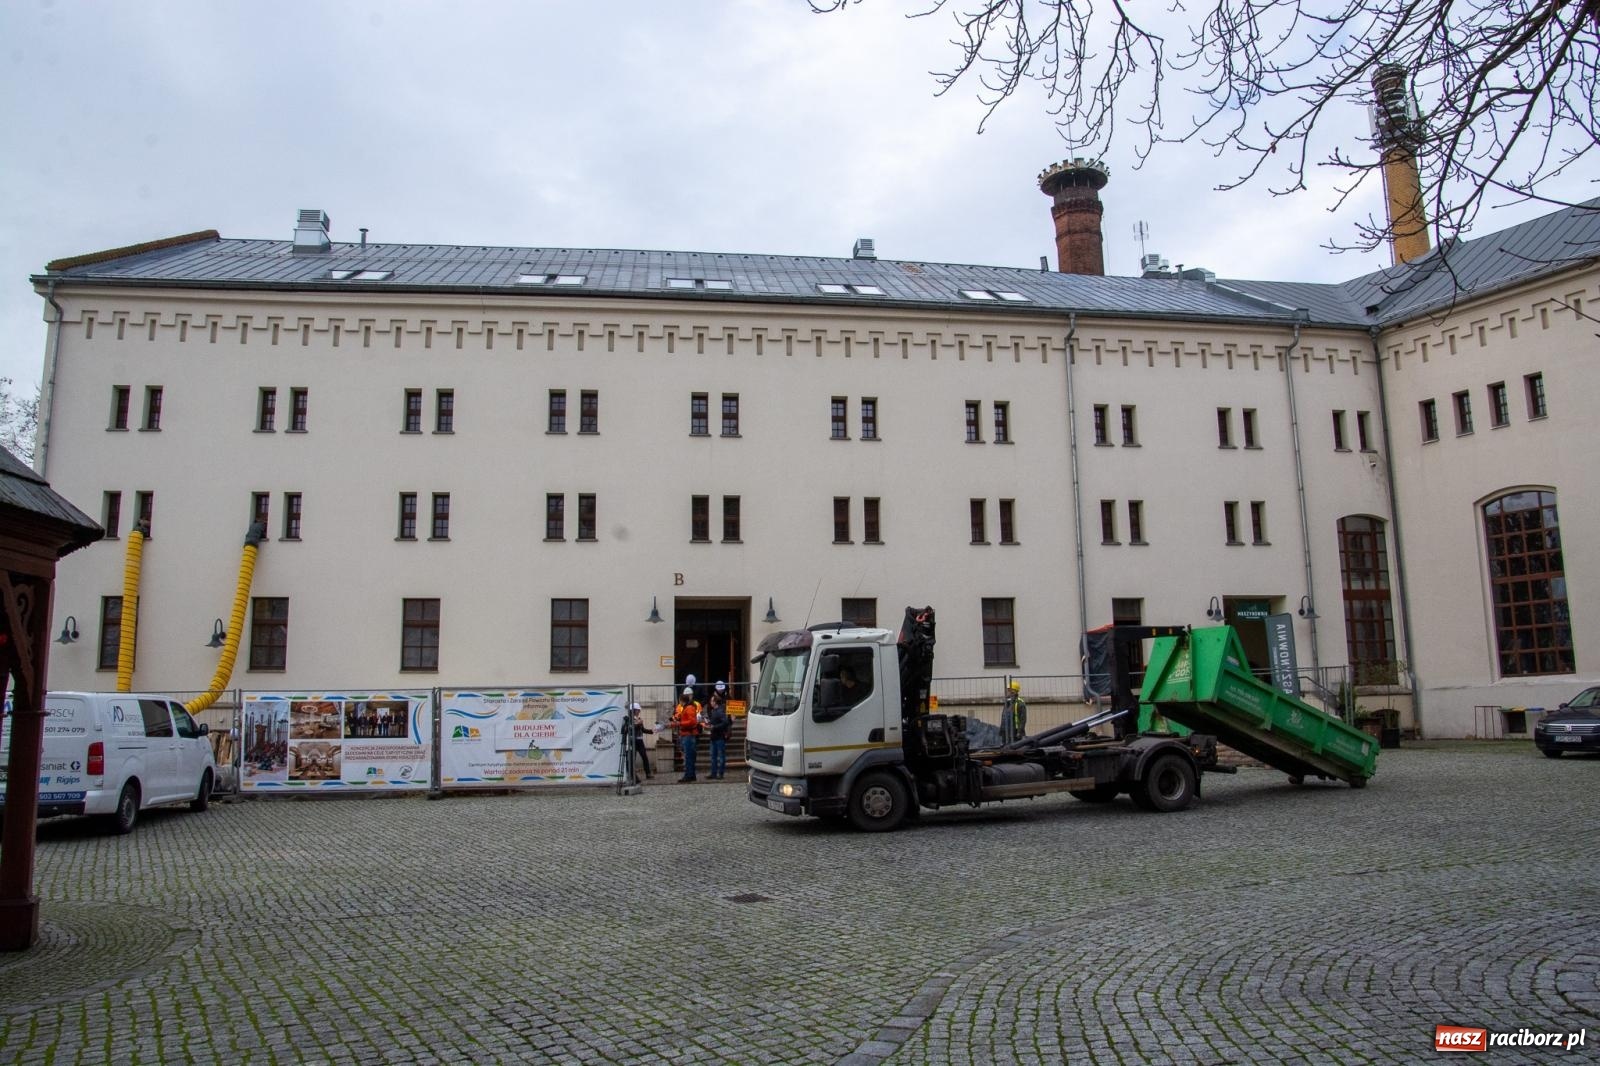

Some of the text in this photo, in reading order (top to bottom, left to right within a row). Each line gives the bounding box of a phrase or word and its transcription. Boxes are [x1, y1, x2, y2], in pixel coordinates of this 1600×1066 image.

[674, 573, 684, 586] B
[513, 724, 556, 732] BUDUJEMY
[56, 776, 81, 785] Rigips
